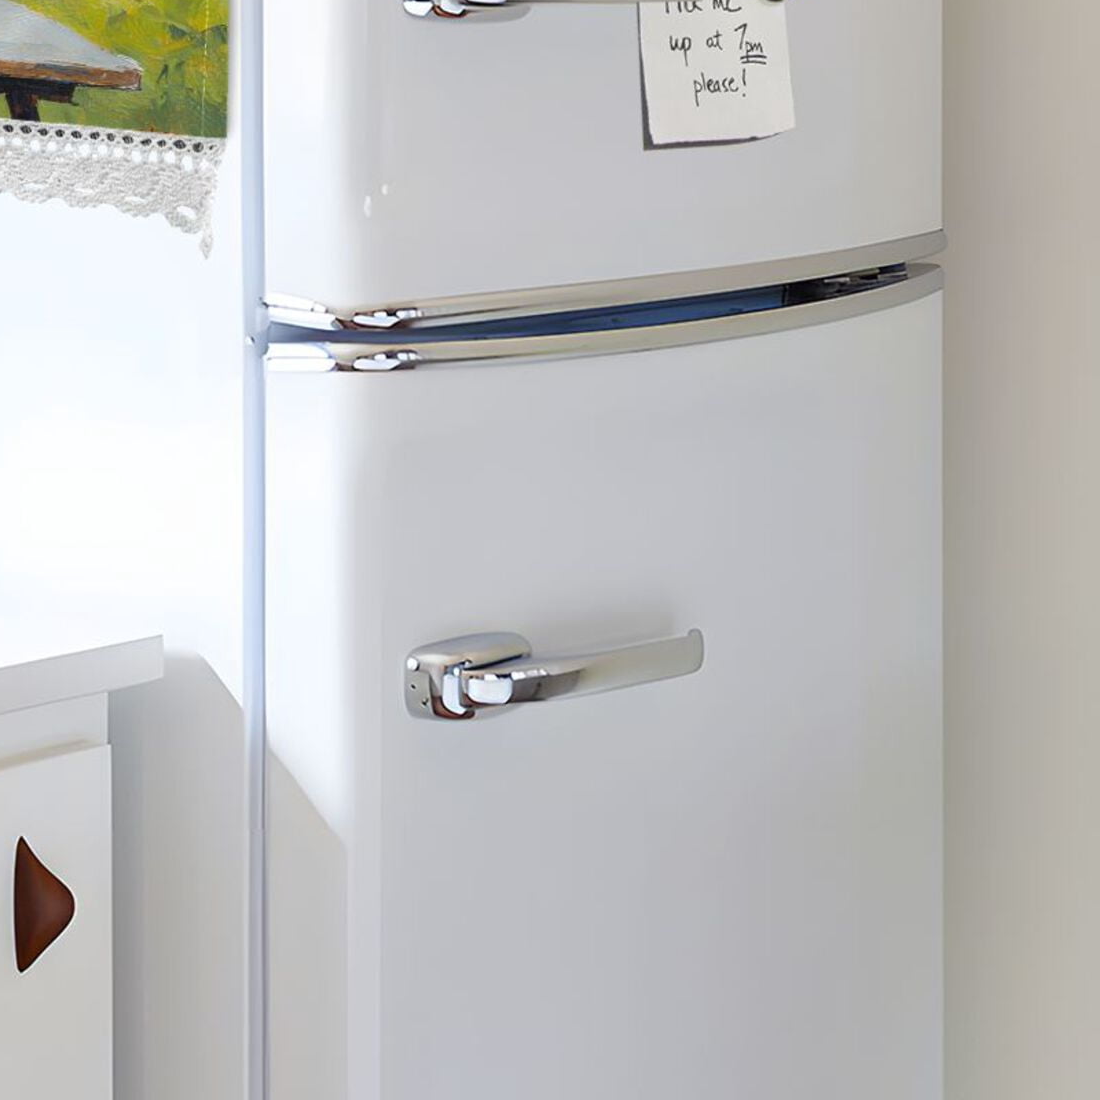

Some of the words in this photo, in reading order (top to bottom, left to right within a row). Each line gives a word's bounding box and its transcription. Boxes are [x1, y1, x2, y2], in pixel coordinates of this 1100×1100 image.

[669, 35, 692, 67] up
[705, 30, 723, 51] at
[693, 68, 747, 107] please!
